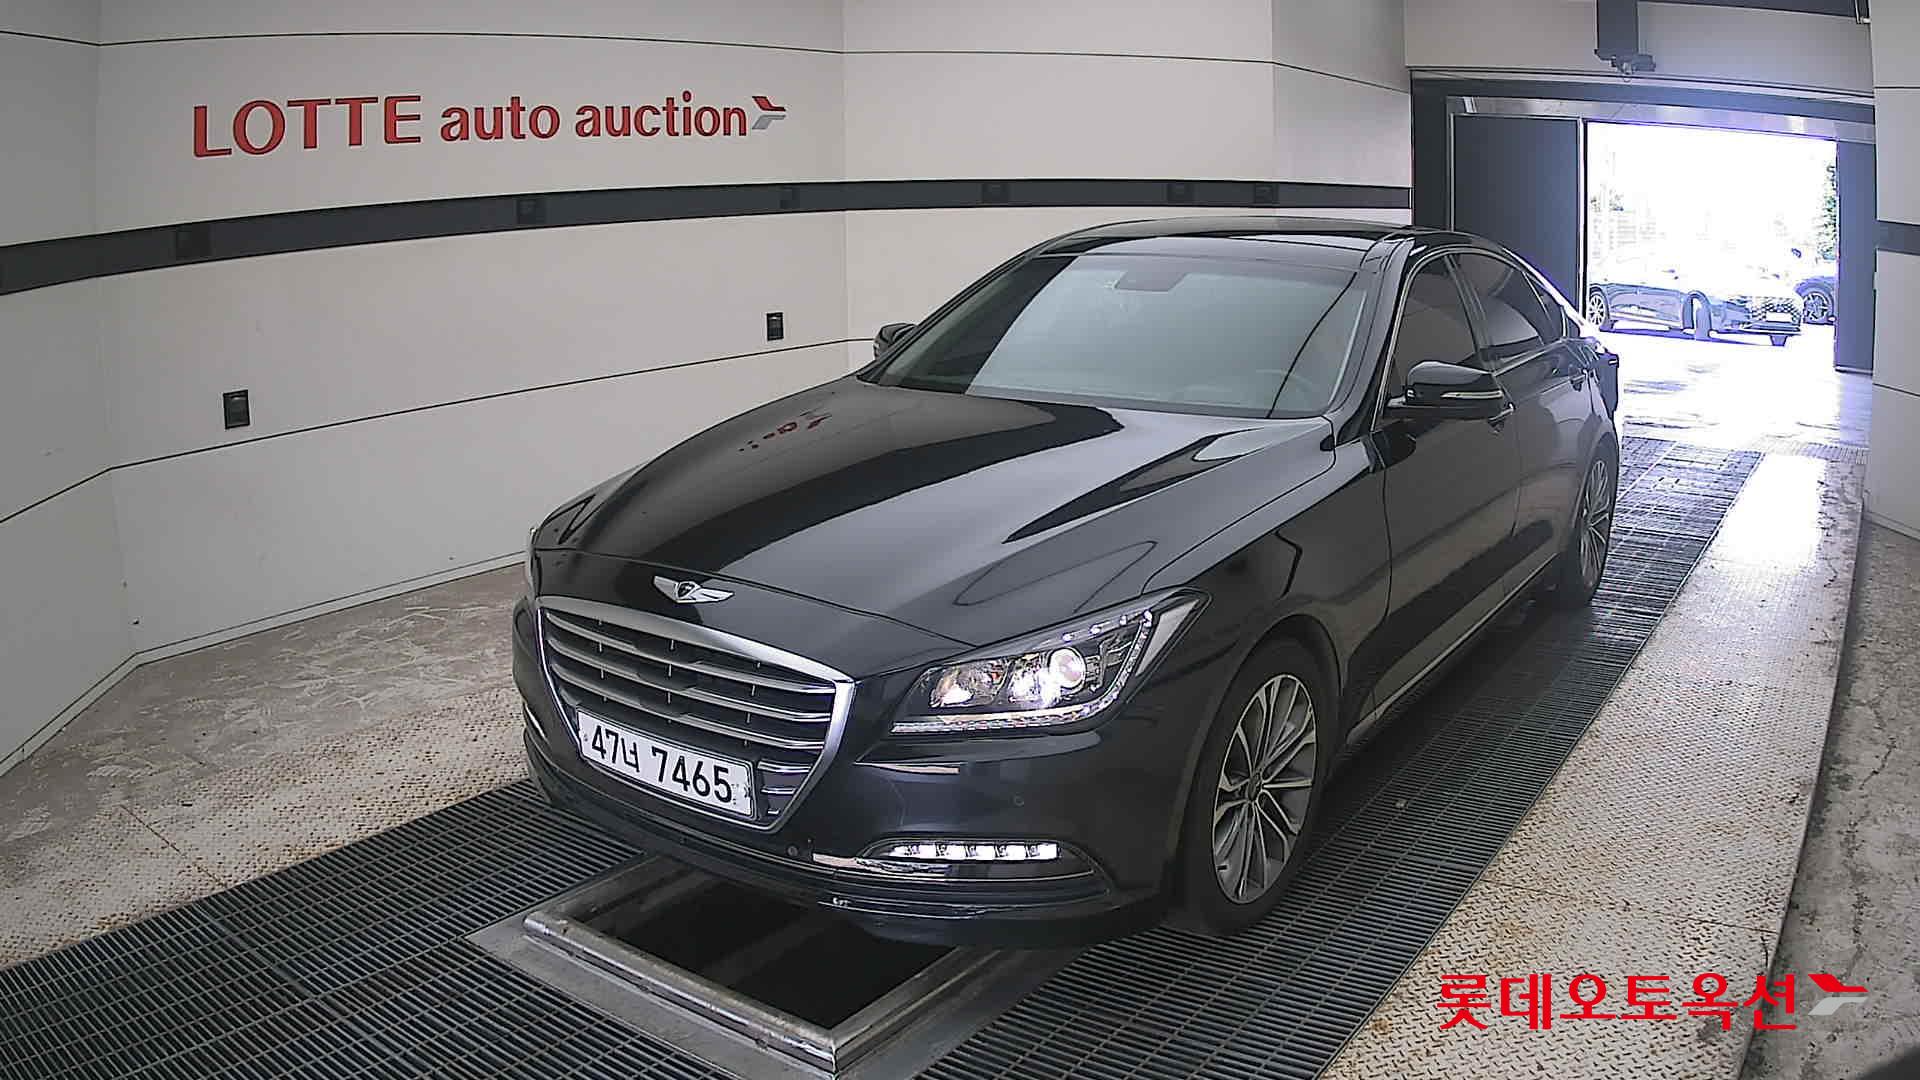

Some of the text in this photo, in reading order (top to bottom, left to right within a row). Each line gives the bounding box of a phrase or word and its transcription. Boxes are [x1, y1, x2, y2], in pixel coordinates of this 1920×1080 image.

[193, 90, 748, 158] LOTTE auto auction
[591, 725, 732, 804] 47너 7465
